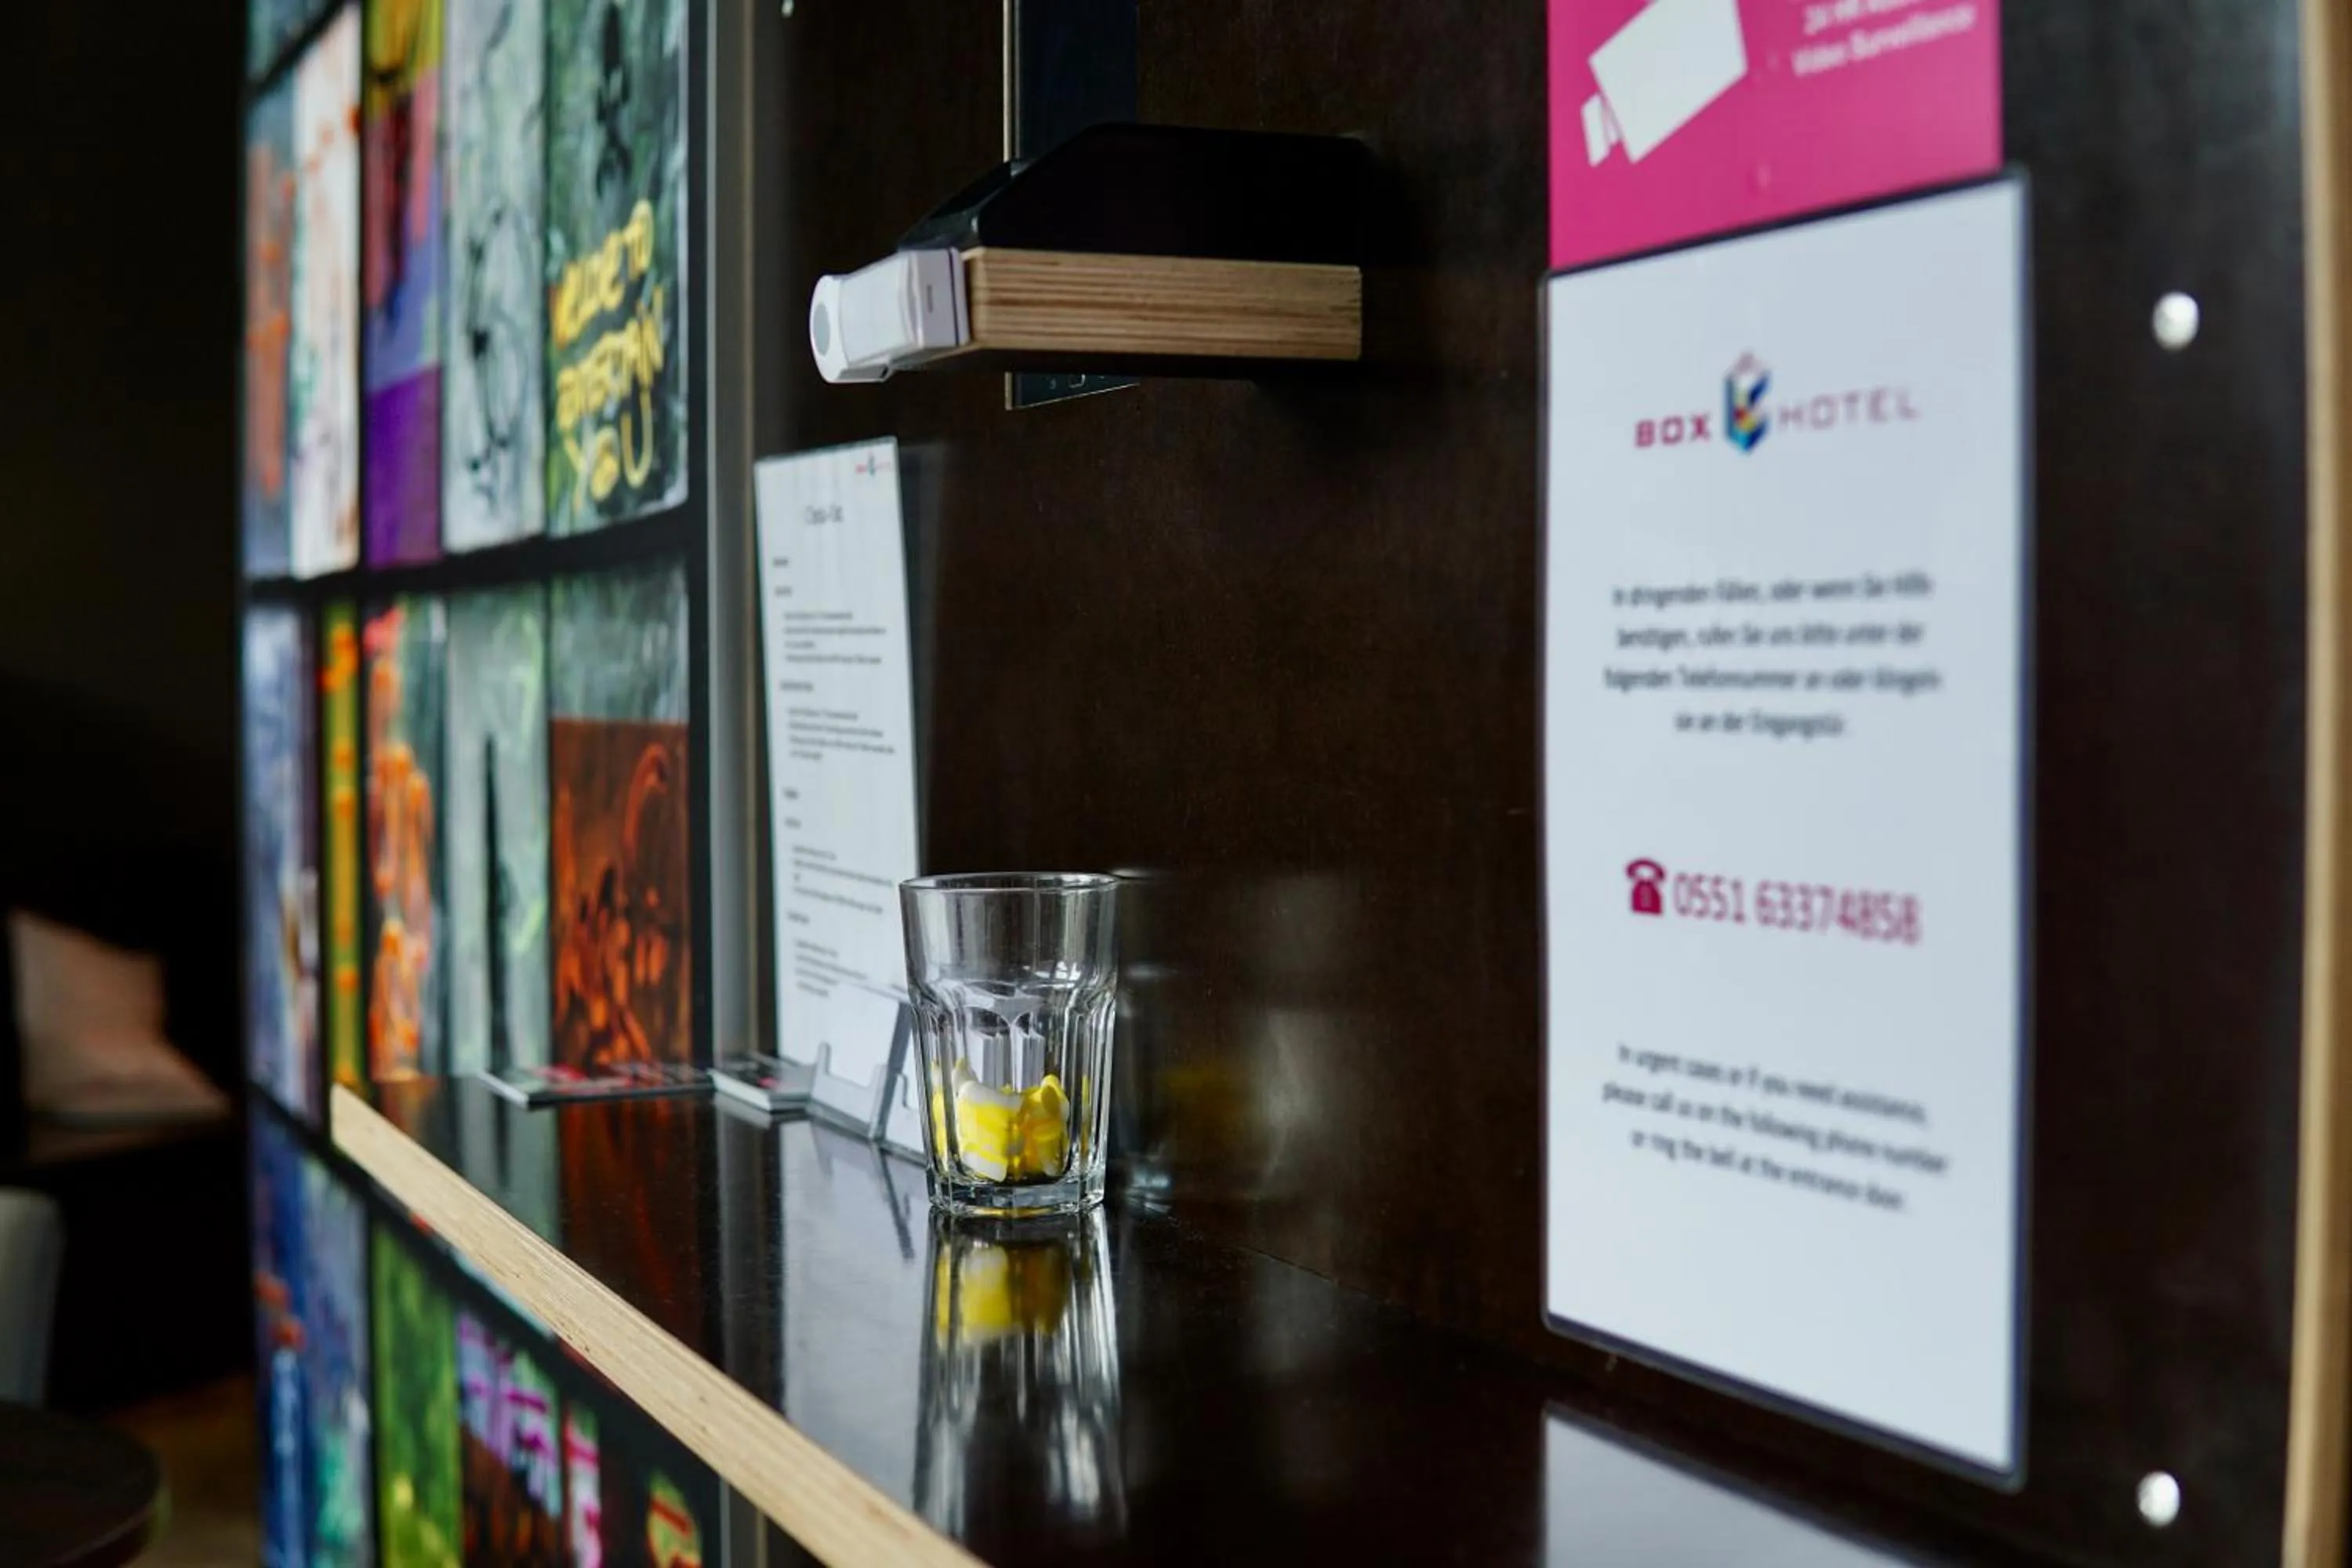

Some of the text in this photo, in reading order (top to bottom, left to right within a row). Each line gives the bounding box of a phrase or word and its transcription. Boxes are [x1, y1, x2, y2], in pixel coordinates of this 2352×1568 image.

[1635, 387, 1921, 448] BOX HOTEL
[1673, 871, 1921, 946] 0551 63374858
